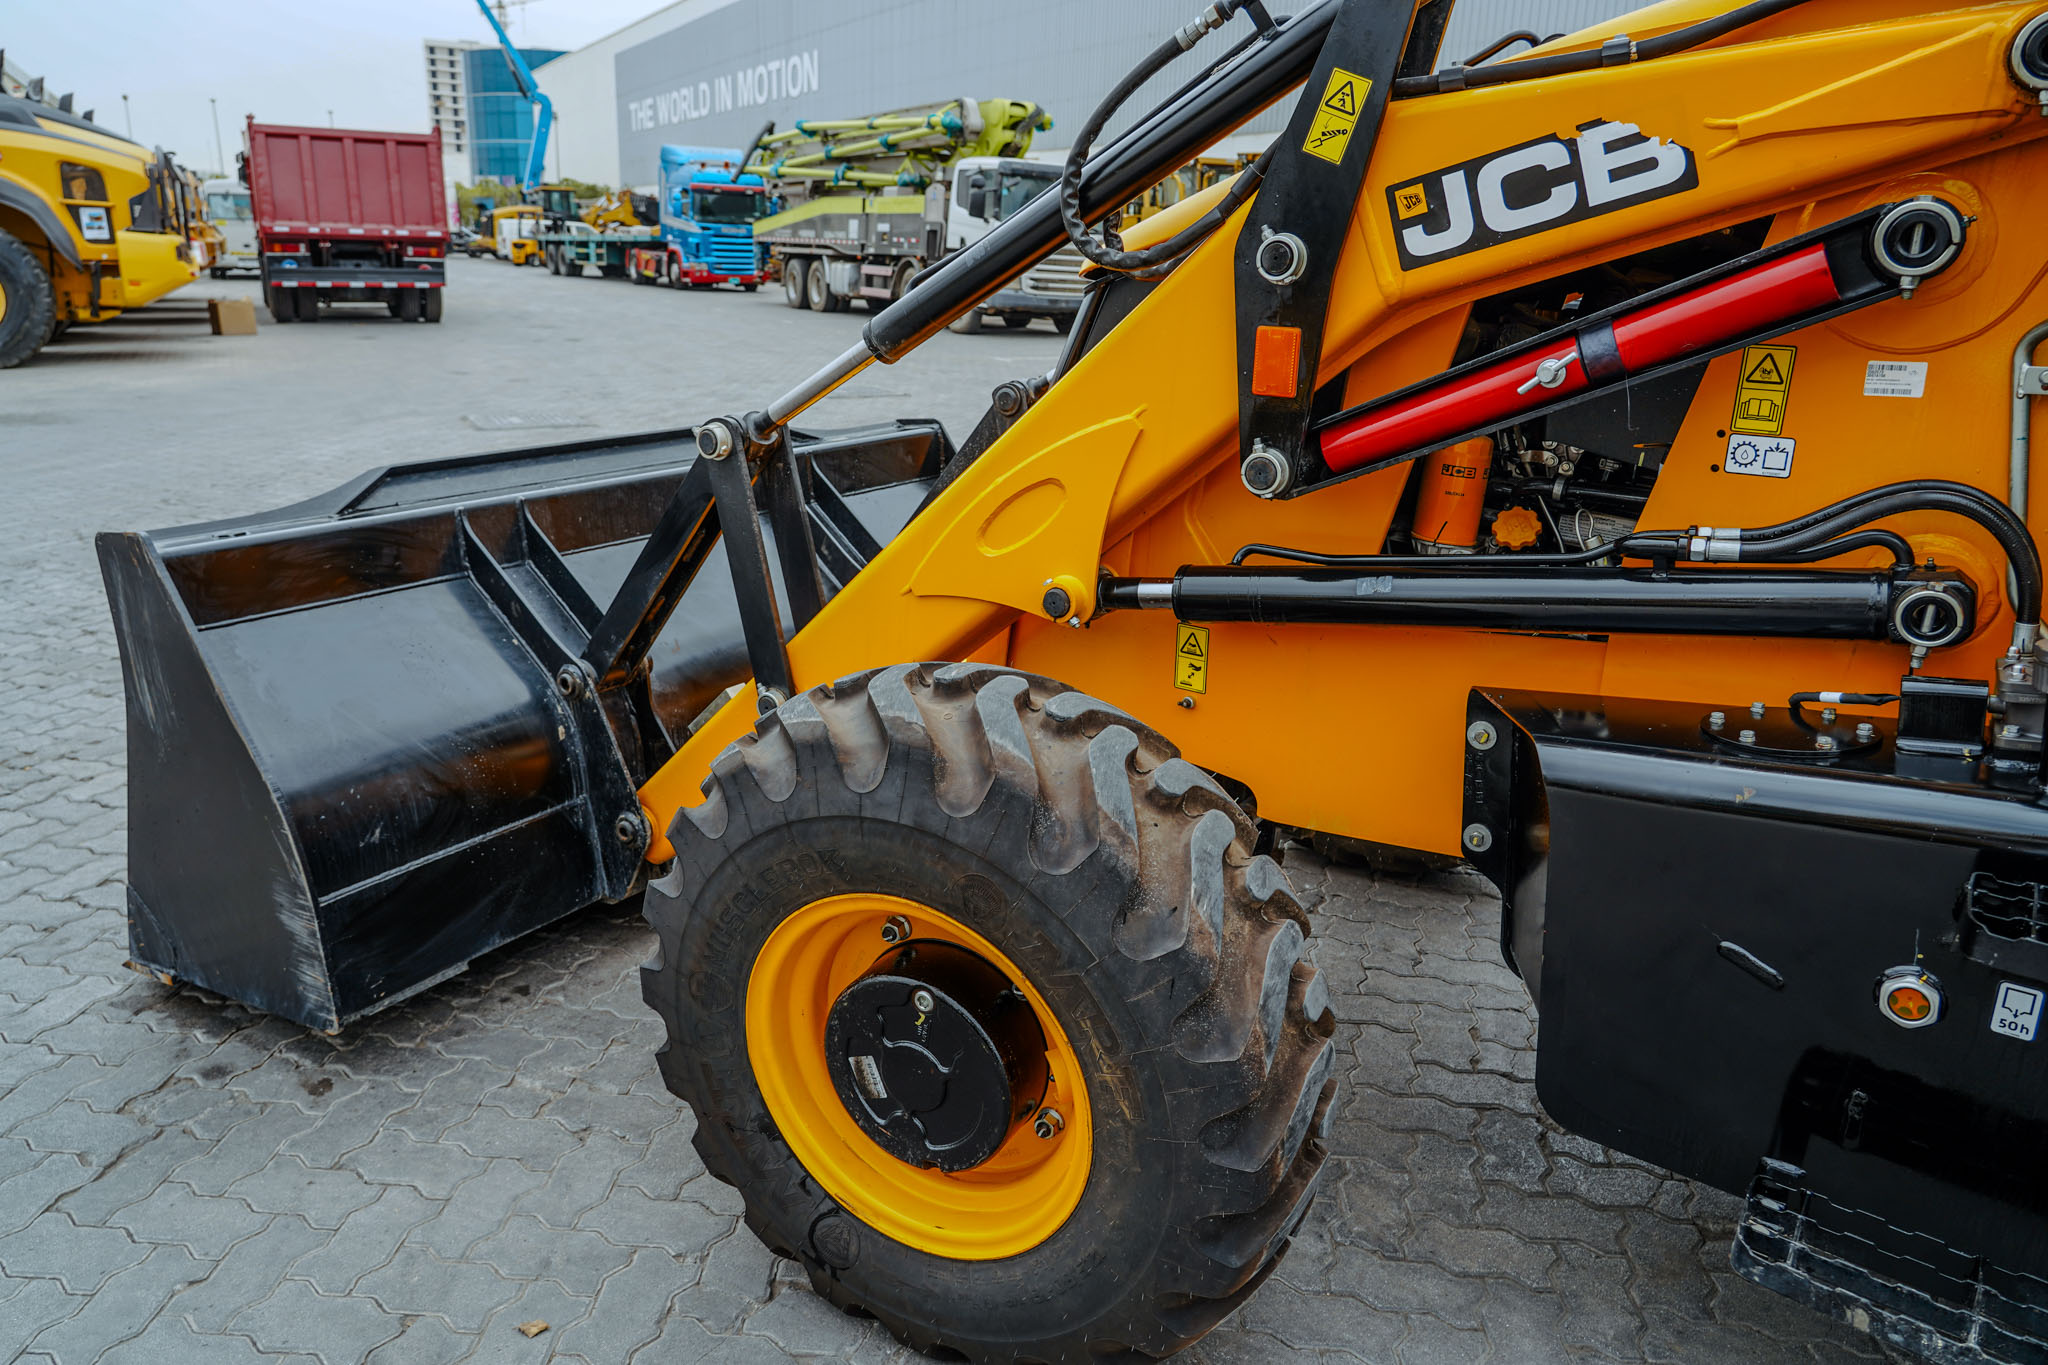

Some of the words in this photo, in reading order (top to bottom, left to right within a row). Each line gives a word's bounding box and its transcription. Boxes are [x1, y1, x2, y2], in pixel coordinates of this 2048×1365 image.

[629, 97, 654, 132] THE
[656, 82, 711, 125] WORLD
[714, 75, 733, 113] IN
[737, 48, 819, 107] MOTION
[1402, 121, 1687, 256] JCB
[1403, 193, 1421, 209] JCB
[1443, 465, 1475, 478] JCB
